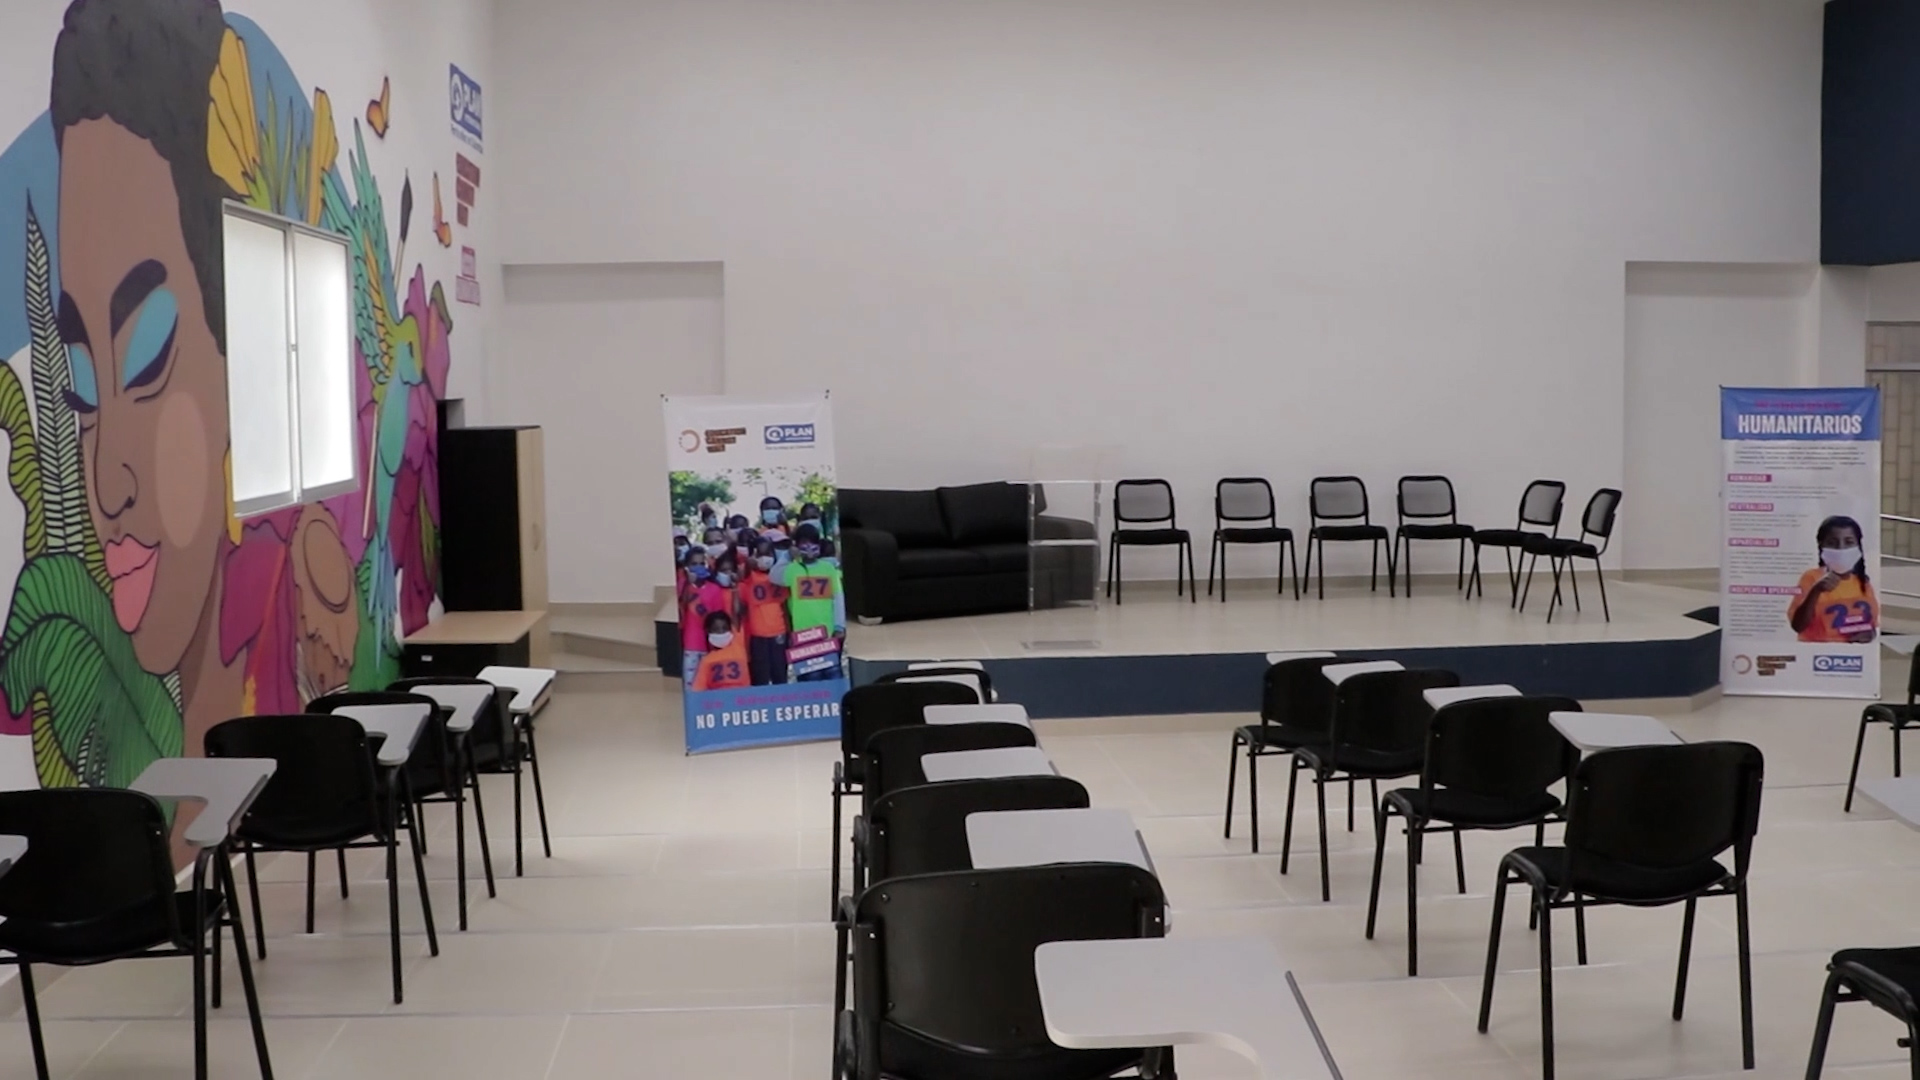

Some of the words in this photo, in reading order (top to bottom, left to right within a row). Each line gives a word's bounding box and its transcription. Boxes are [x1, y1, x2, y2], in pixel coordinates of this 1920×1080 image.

[785, 427, 813, 438] PLAN
[1738, 414, 1863, 434] HUMANITARIOS
[801, 578, 829, 597] 27
[711, 661, 741, 682] 23
[1833, 658, 1861, 667] PLAN
[696, 713, 715, 729] NO
[722, 708, 769, 727] PUEDE
[775, 702, 841, 722] ESPERAR
